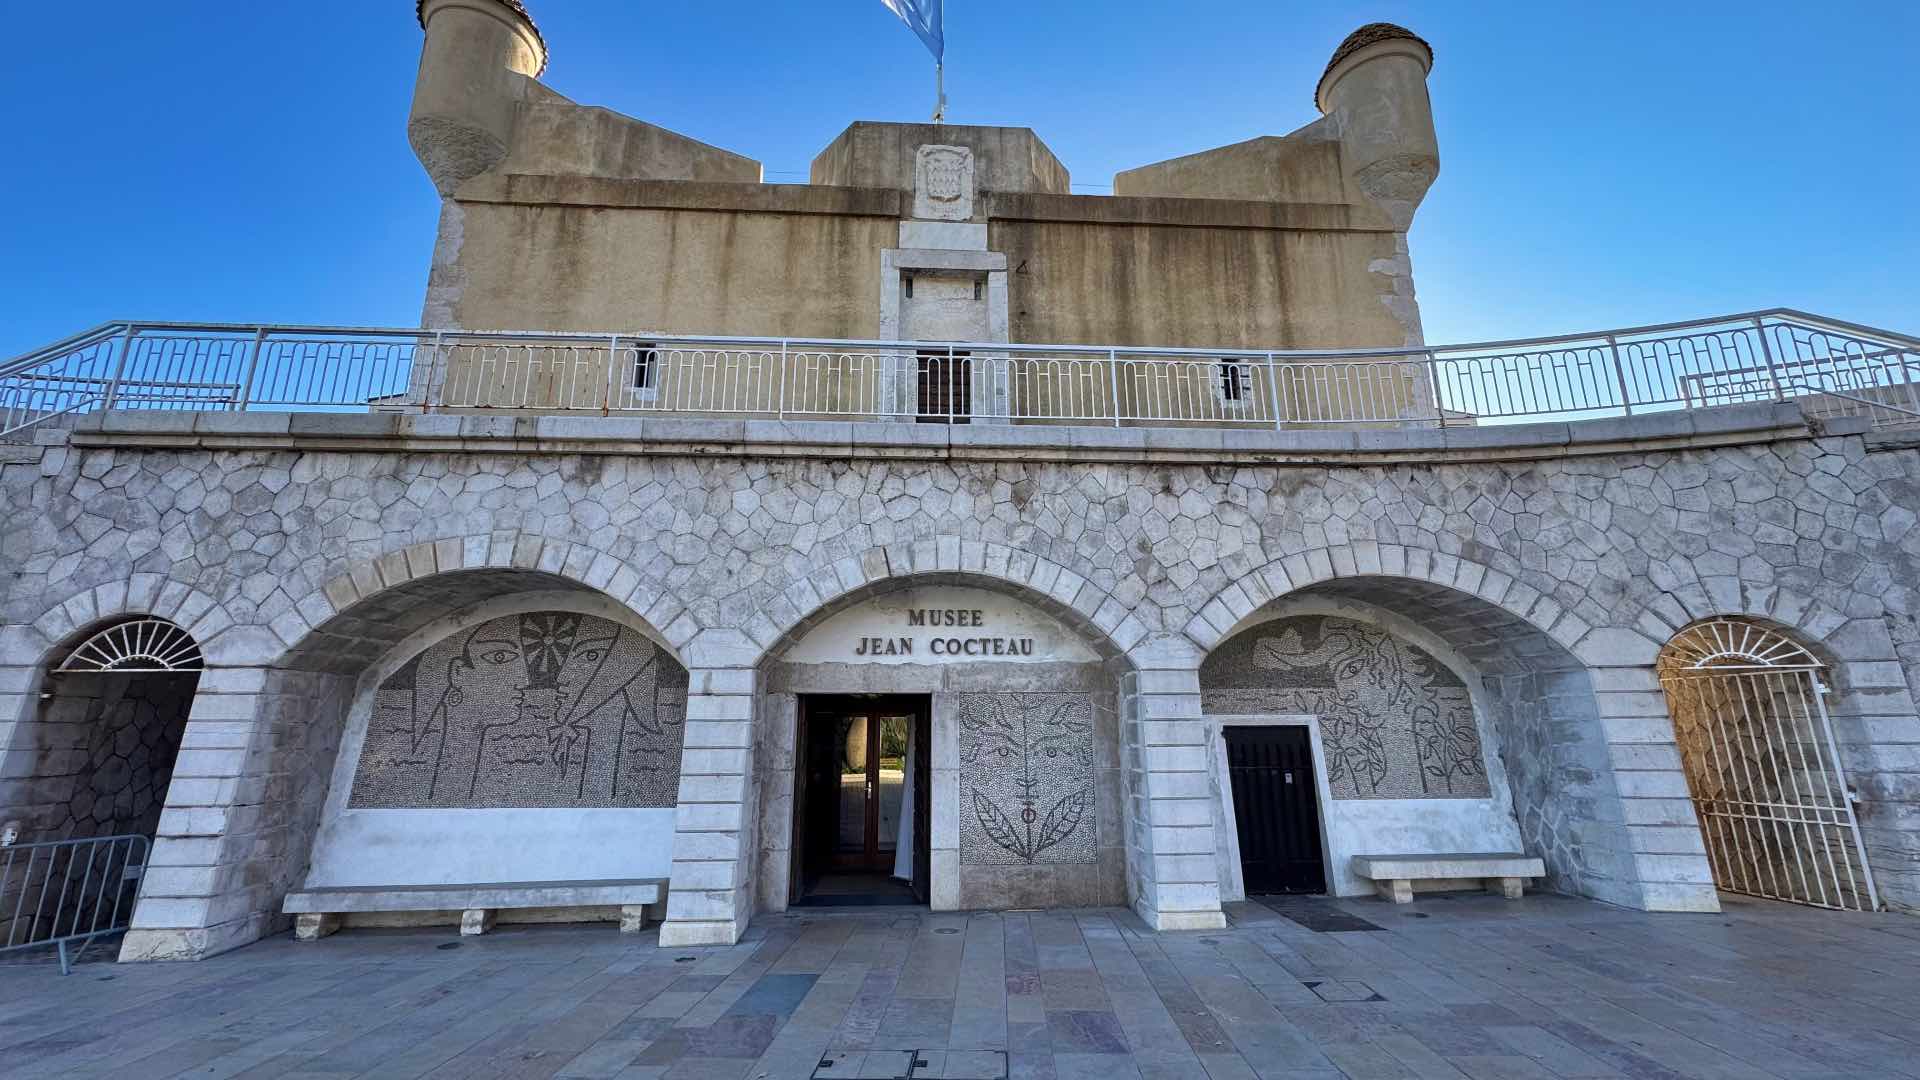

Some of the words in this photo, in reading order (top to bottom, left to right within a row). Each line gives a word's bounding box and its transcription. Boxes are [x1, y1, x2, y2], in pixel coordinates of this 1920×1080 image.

[907, 608, 984, 627] MUSEE
[855, 637, 913, 656] JEAN
[929, 637, 1033, 657] COCTEAU
